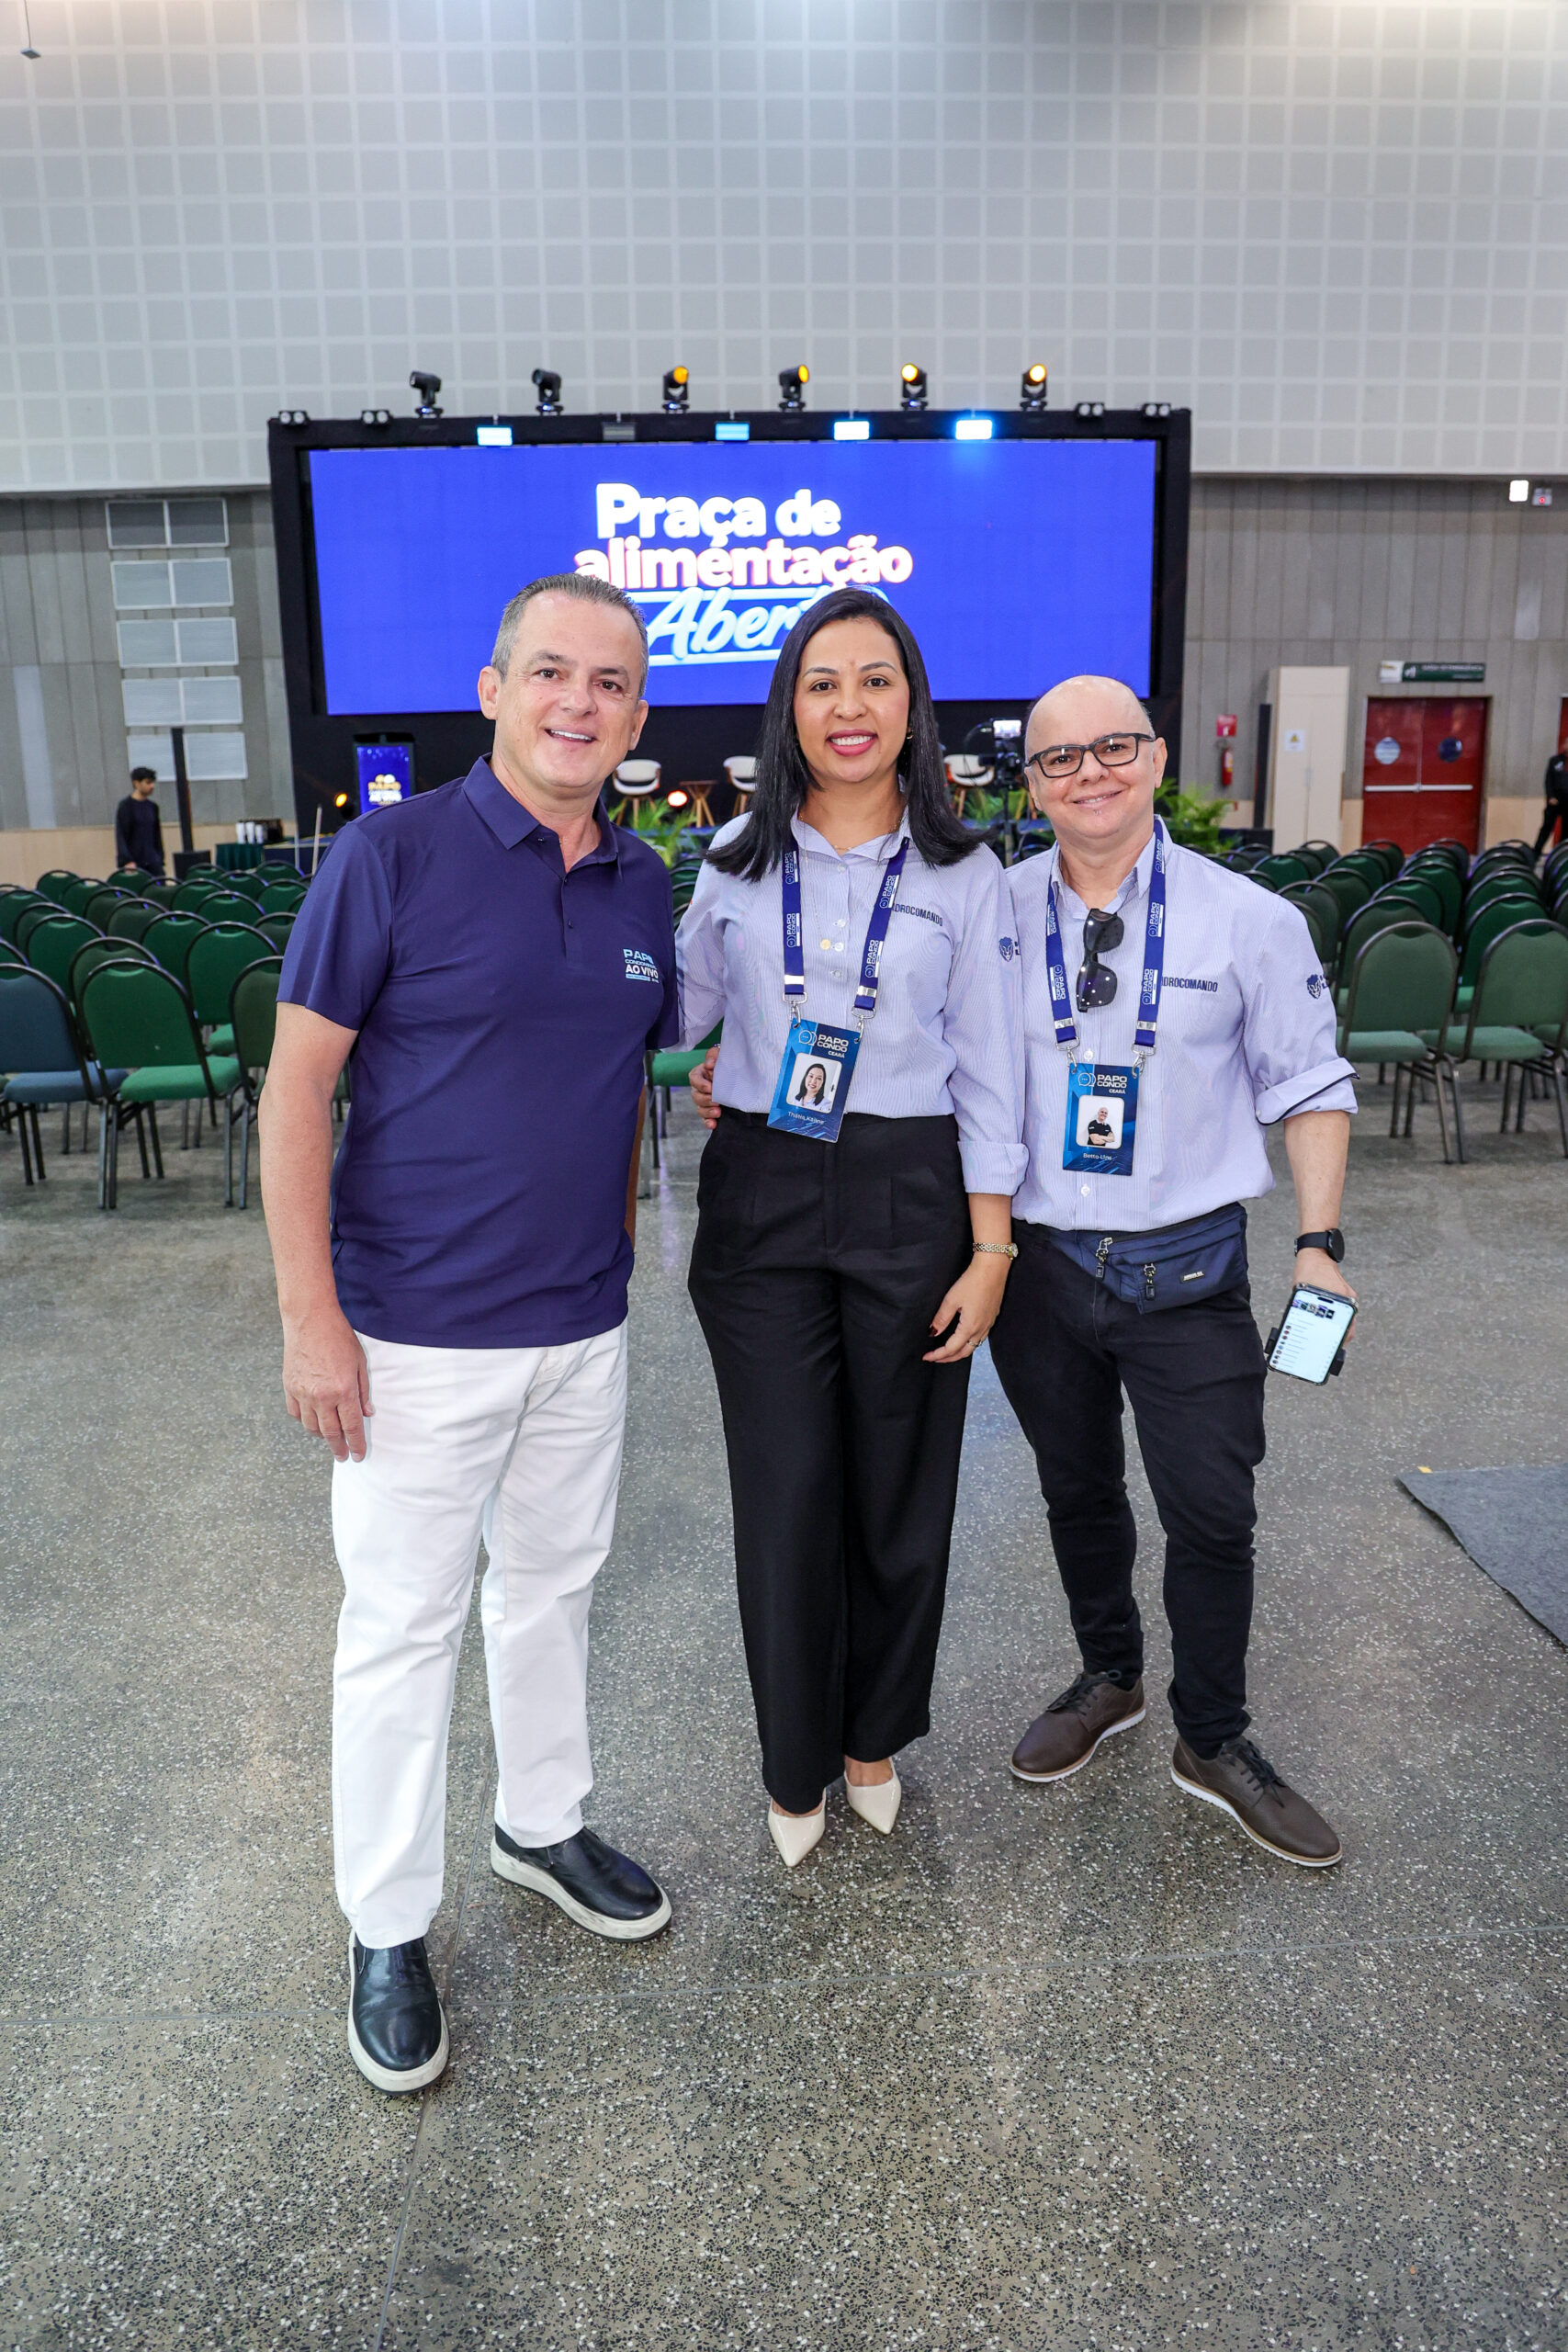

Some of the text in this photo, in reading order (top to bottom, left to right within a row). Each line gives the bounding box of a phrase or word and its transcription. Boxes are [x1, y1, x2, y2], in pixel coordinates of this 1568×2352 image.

[595, 482, 841, 548] Praça de
[574, 534, 913, 590] alimentação
[648, 586, 829, 661] Aber
[883, 875, 893, 897] PAPO
[893, 903, 943, 926] DROCOMANDO
[866, 939, 875, 964] PAPO
[626, 965, 640, 975] AO
[641, 966, 659, 979] VIVO
[1058, 976, 1066, 1000] PAPO
[1161, 977, 1218, 992] IDROCOMANDO
[817, 1041, 848, 1053] CONDO
[818, 1034, 849, 1047] PAPO
[1097, 1074, 1127, 1083] PAPO
[1097, 1080, 1127, 1089] CONDO
